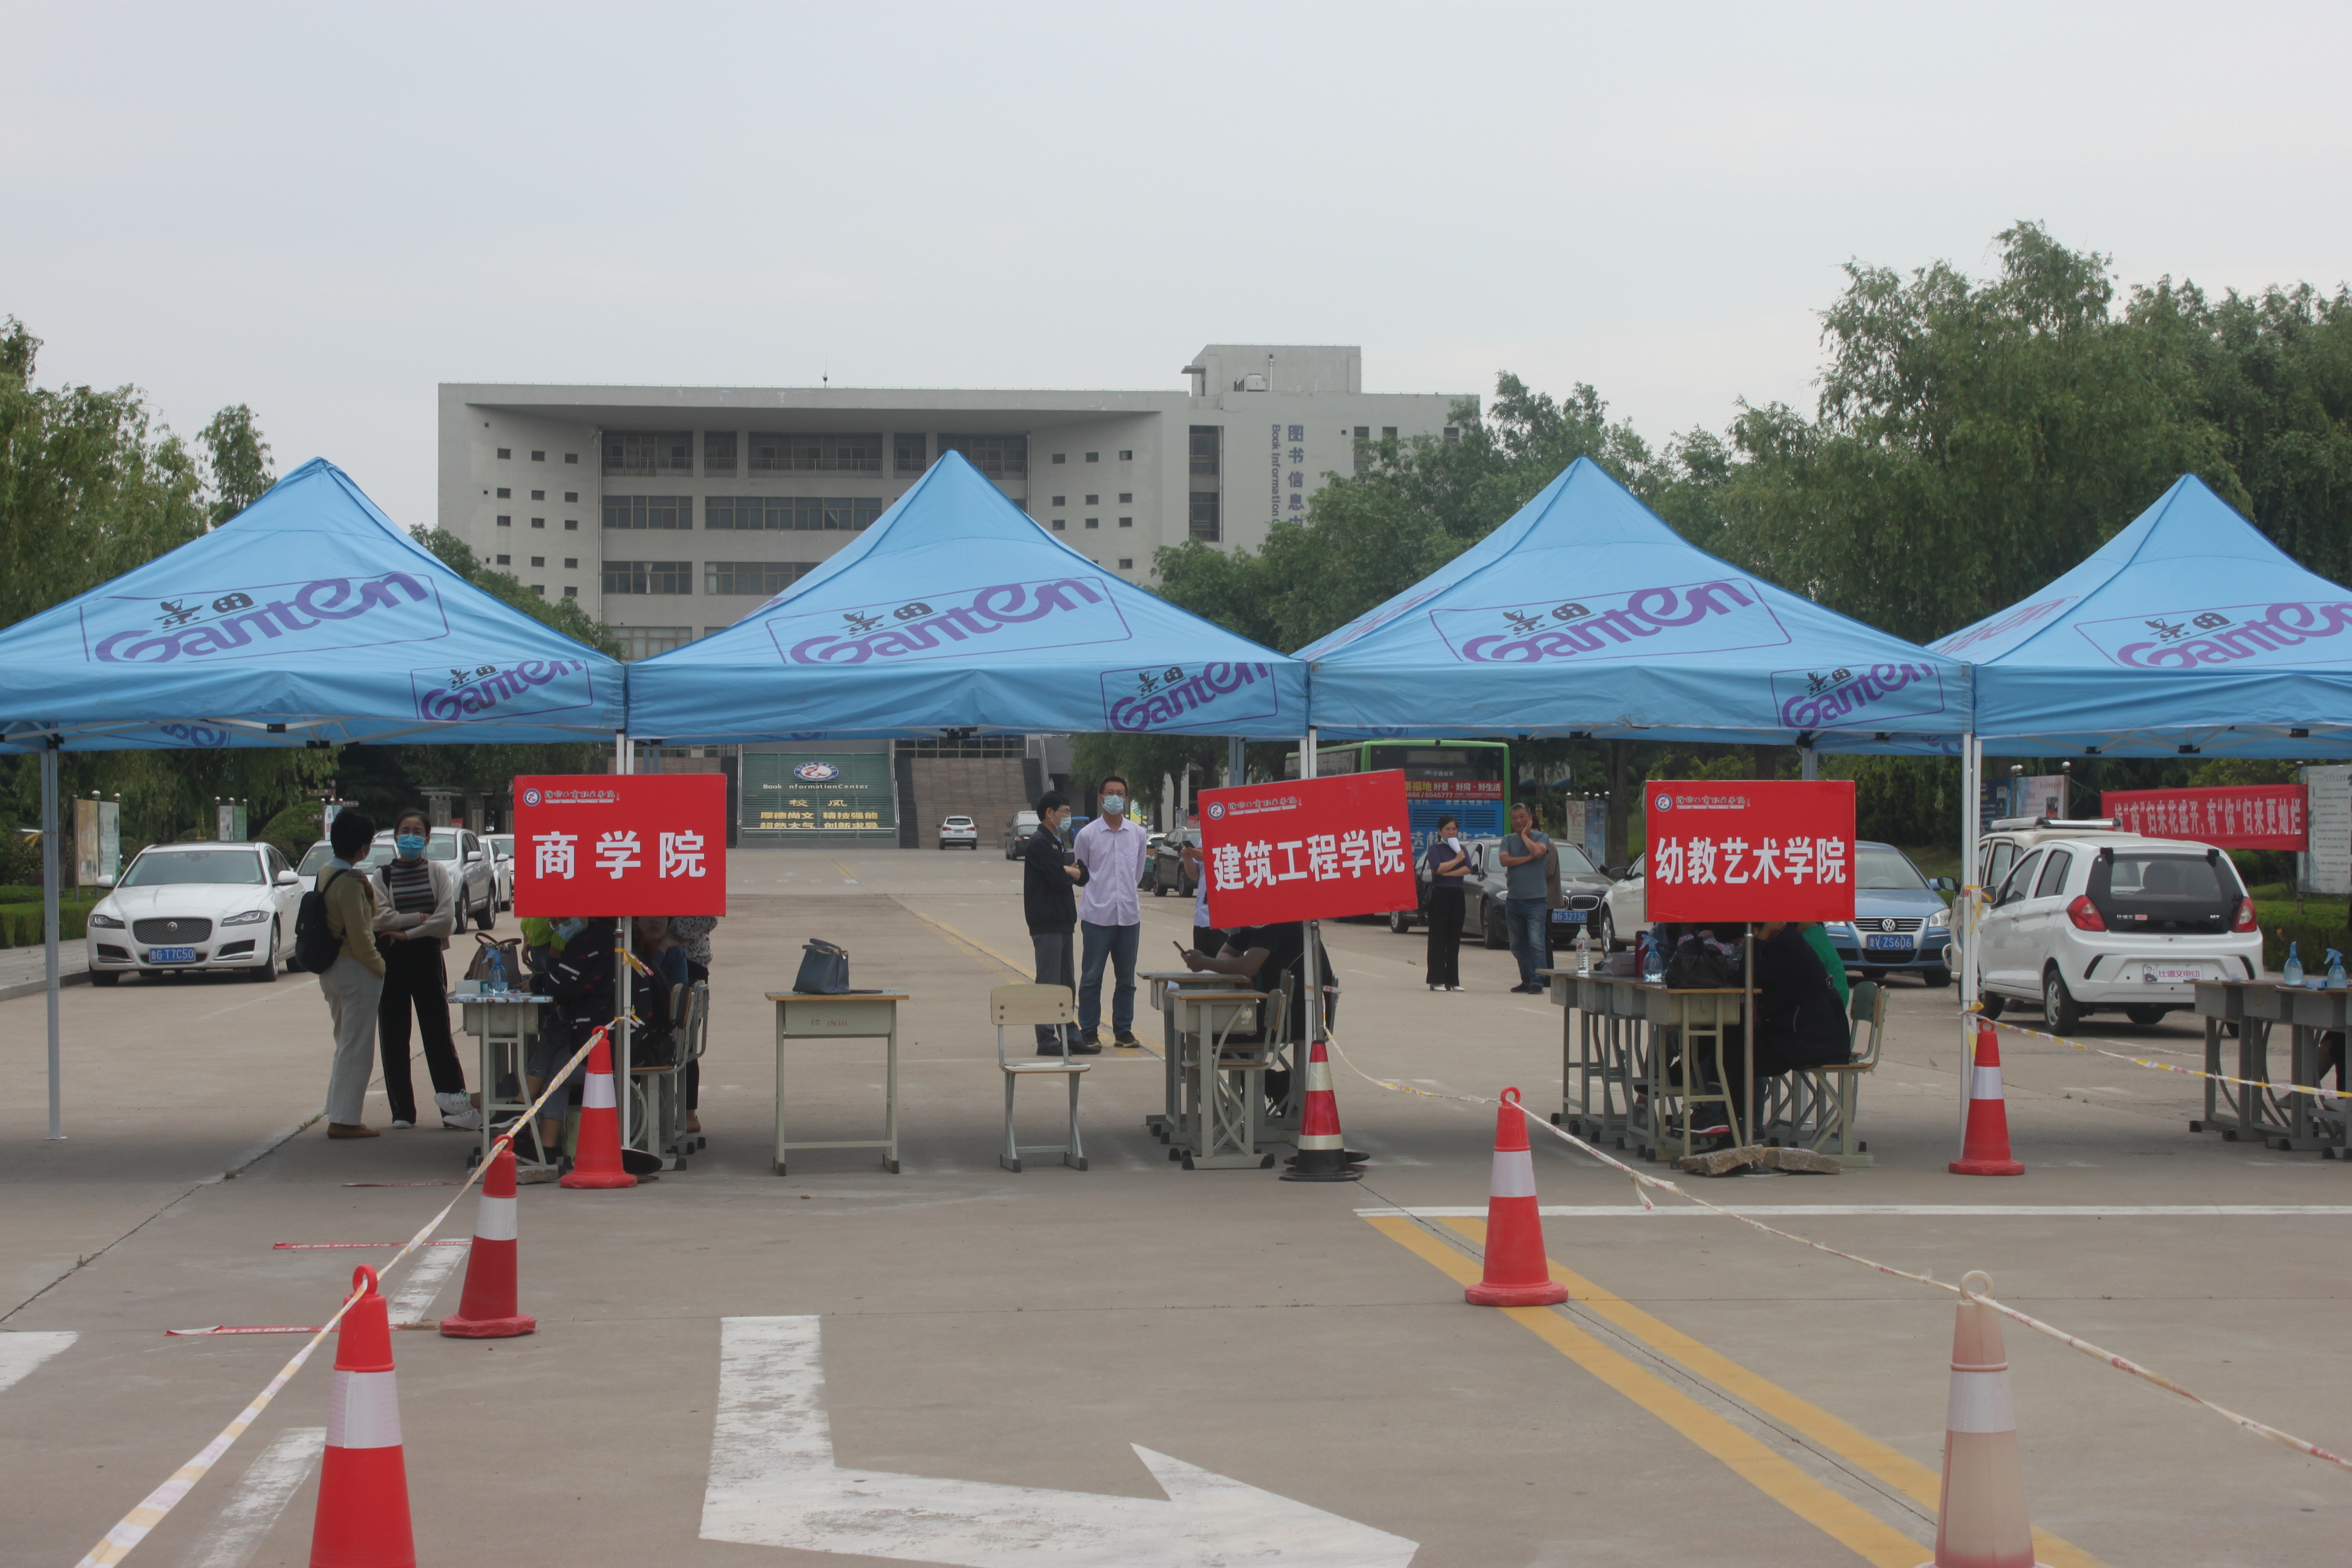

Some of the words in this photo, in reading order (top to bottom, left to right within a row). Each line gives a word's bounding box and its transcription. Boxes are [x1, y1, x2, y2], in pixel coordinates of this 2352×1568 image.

[1272, 424, 1280, 449] Book
[1272, 453, 1280, 516] Information
[533, 830, 706, 880] 商学院
[1212, 826, 1405, 892] 建筑工程学院
[1655, 836, 1847, 885] 幼教艺术学院
